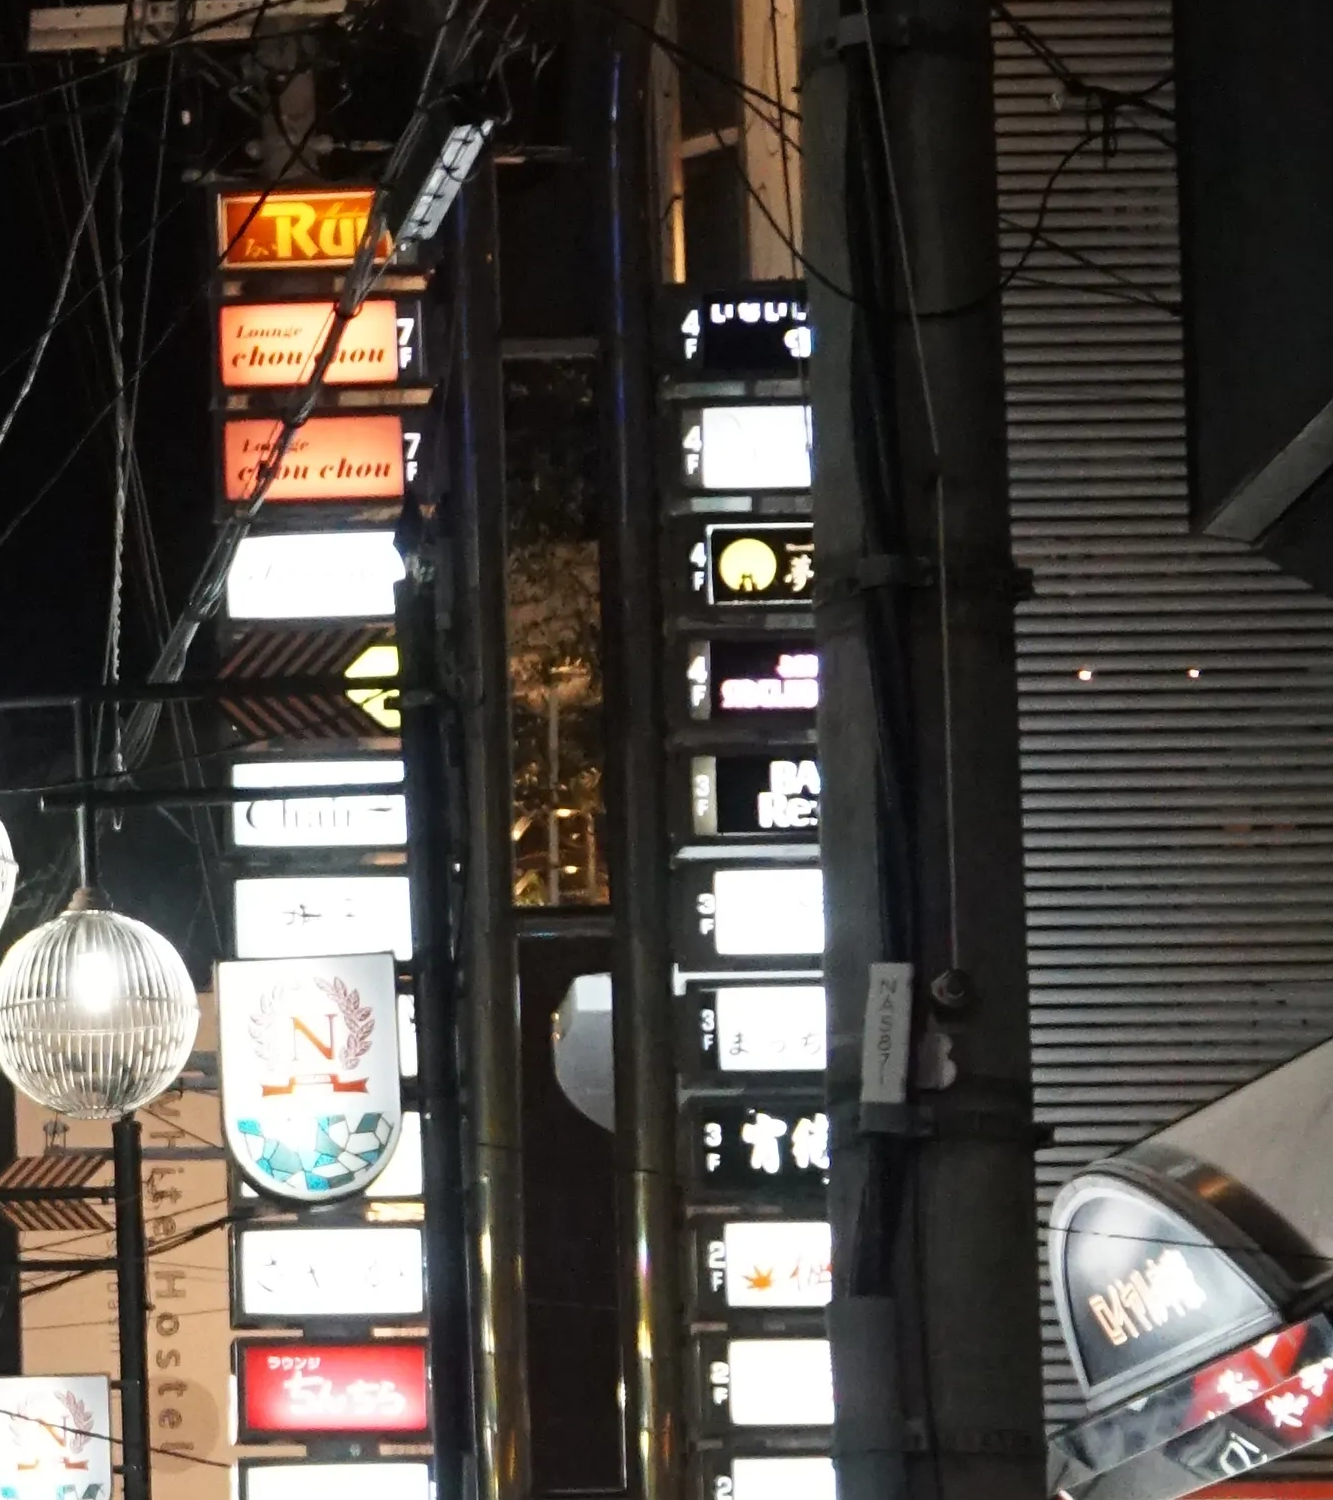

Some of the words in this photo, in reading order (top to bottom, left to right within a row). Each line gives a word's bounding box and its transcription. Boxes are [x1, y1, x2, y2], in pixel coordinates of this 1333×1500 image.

[235, 324, 303, 339] Lounge
[231, 345, 303, 368] chou
[315, 345, 385, 365] ou
[242, 437, 309, 453] Loge
[237, 459, 308, 483] cou
[319, 456, 392, 480] chou
[154, 1270, 195, 1452] Hostel
[267, 1356, 321, 1370] ラウンジ
